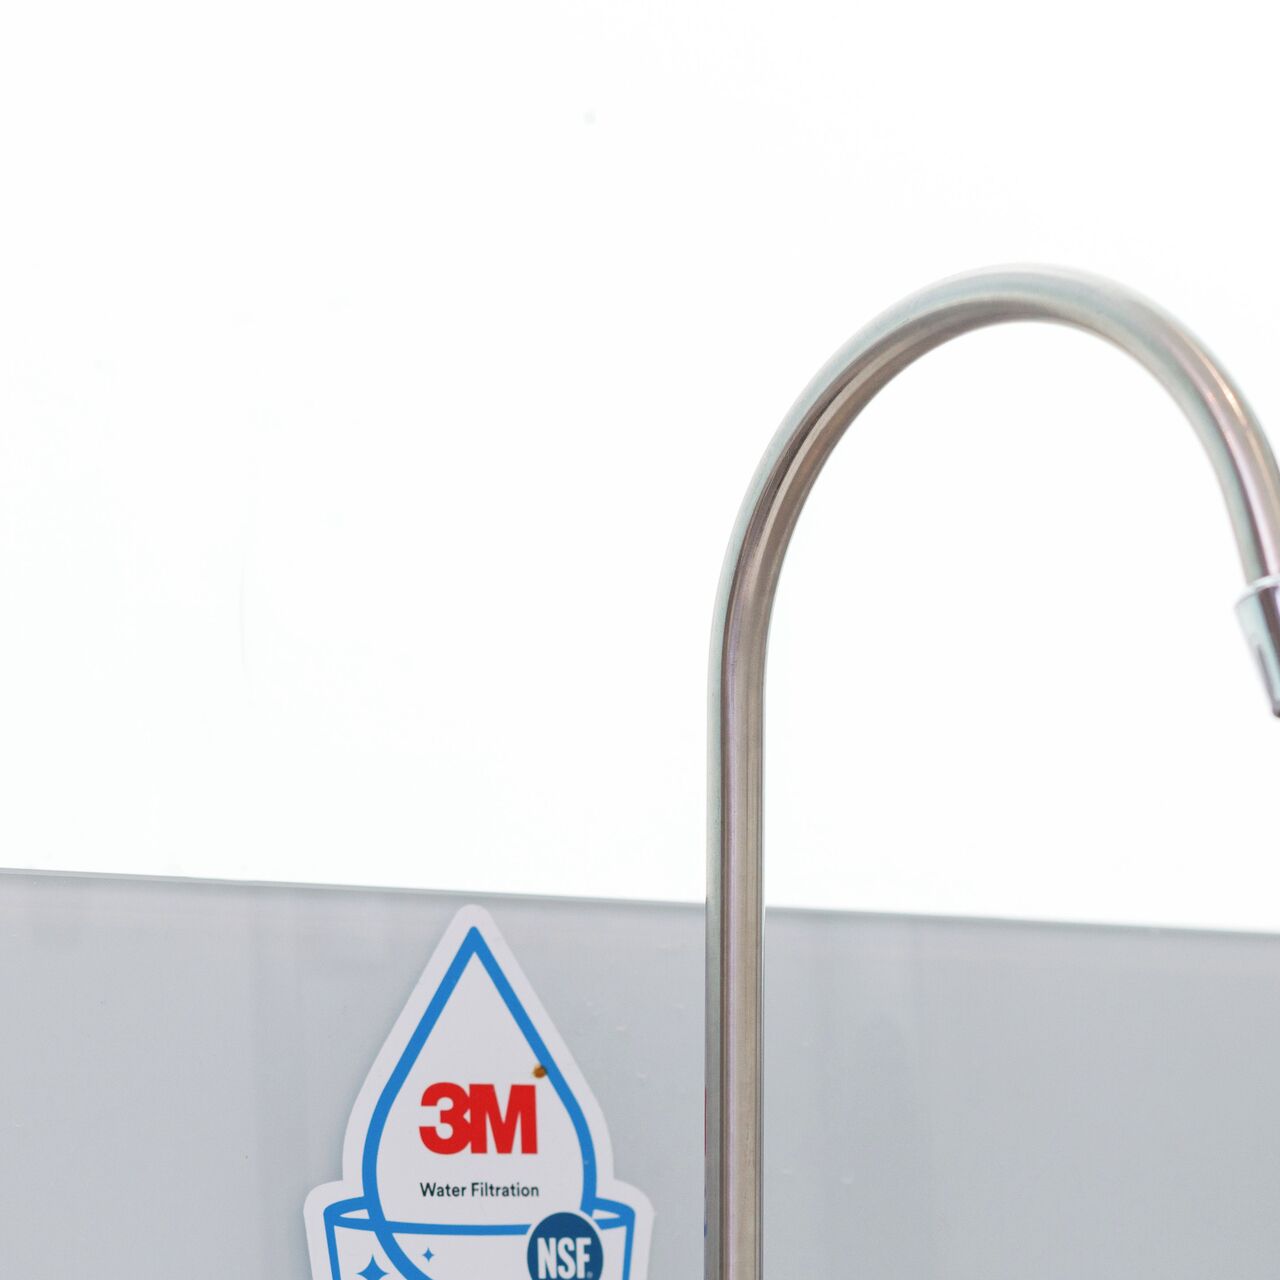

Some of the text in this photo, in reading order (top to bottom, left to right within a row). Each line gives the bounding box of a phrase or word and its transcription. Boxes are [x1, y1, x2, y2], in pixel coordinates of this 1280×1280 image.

[419, 1082, 538, 1155] 3M
[420, 1181, 540, 1198] Water Filtration
